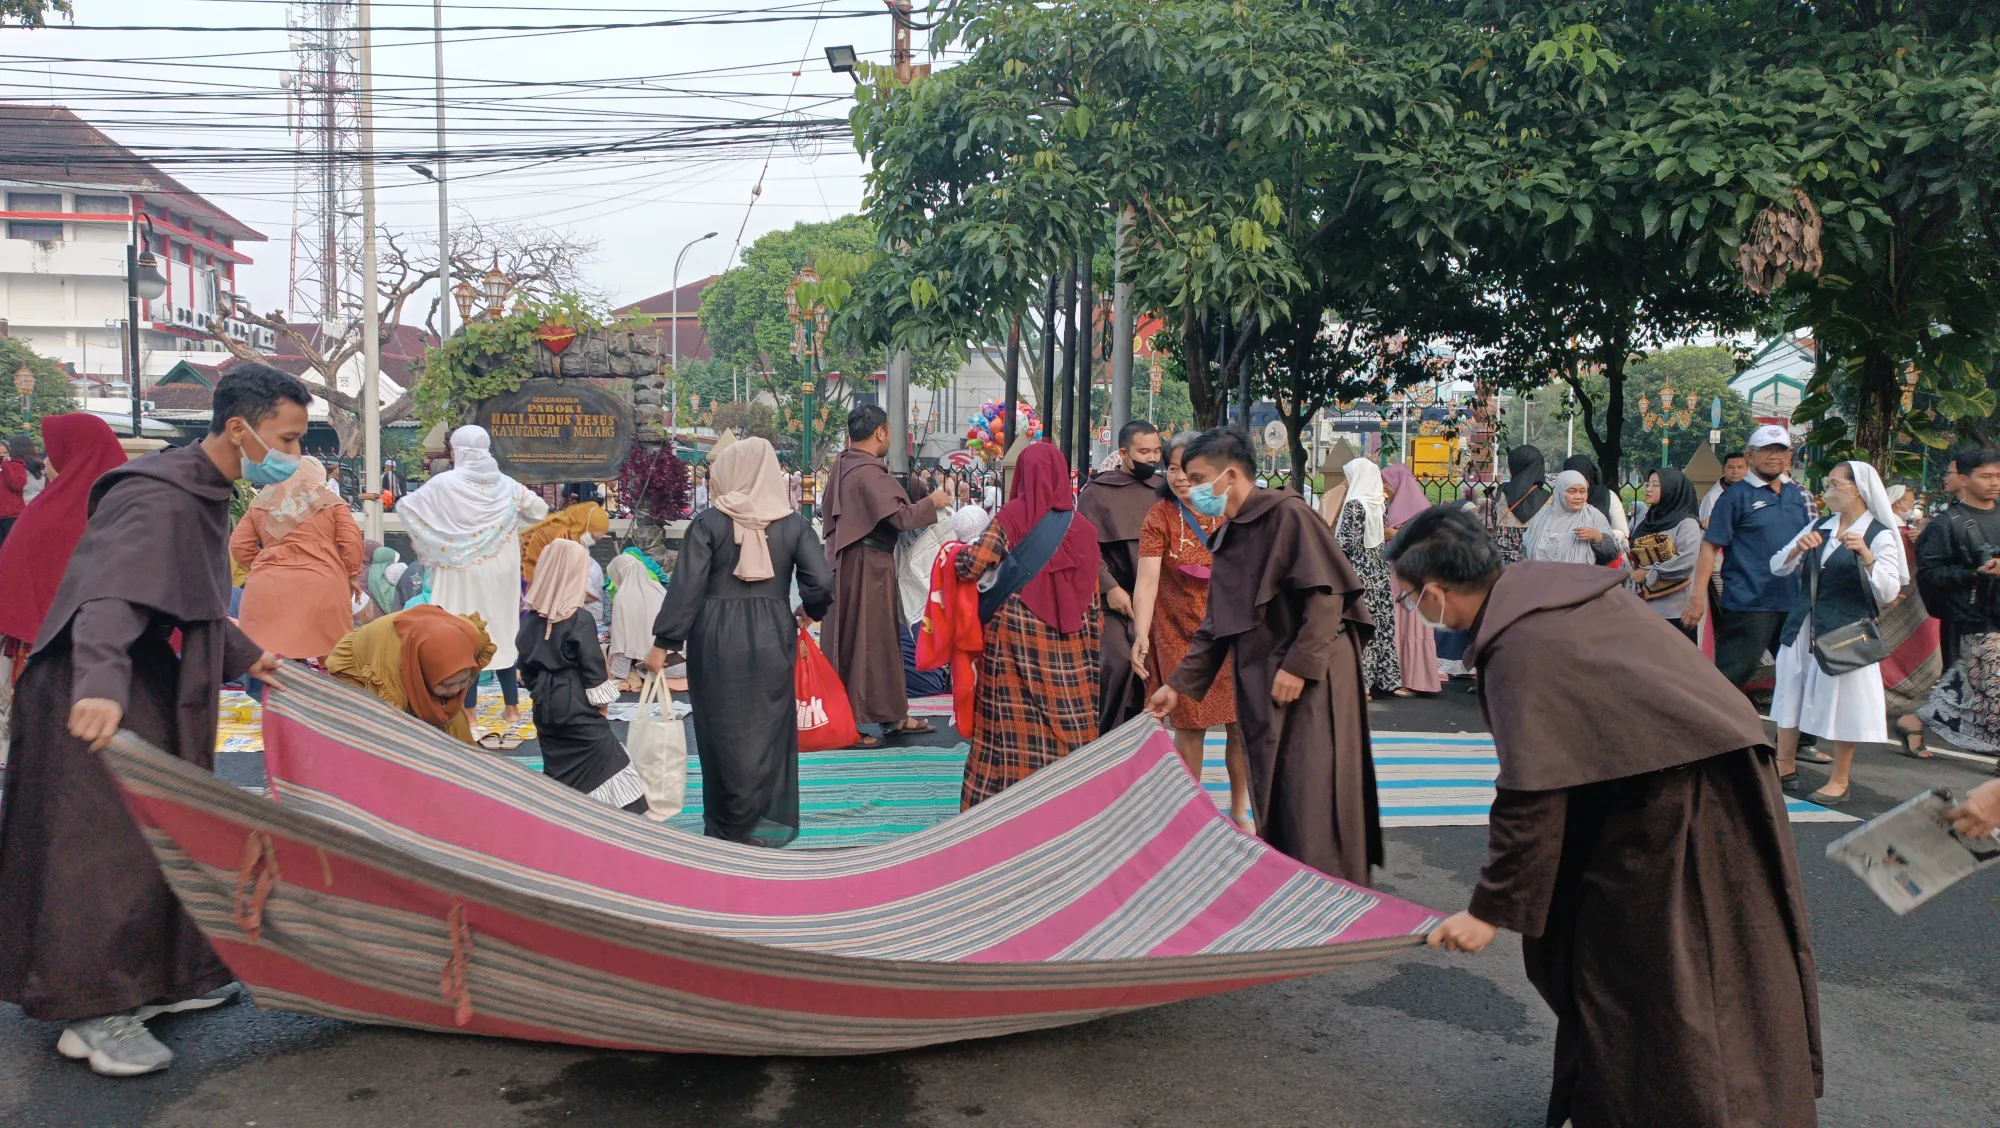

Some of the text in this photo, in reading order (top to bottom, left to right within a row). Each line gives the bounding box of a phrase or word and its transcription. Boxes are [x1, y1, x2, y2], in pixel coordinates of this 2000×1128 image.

[491, 413, 615, 426] HATI KUDUS YESUS
[491, 425, 615, 438] KAYUTANGAN MALANG
